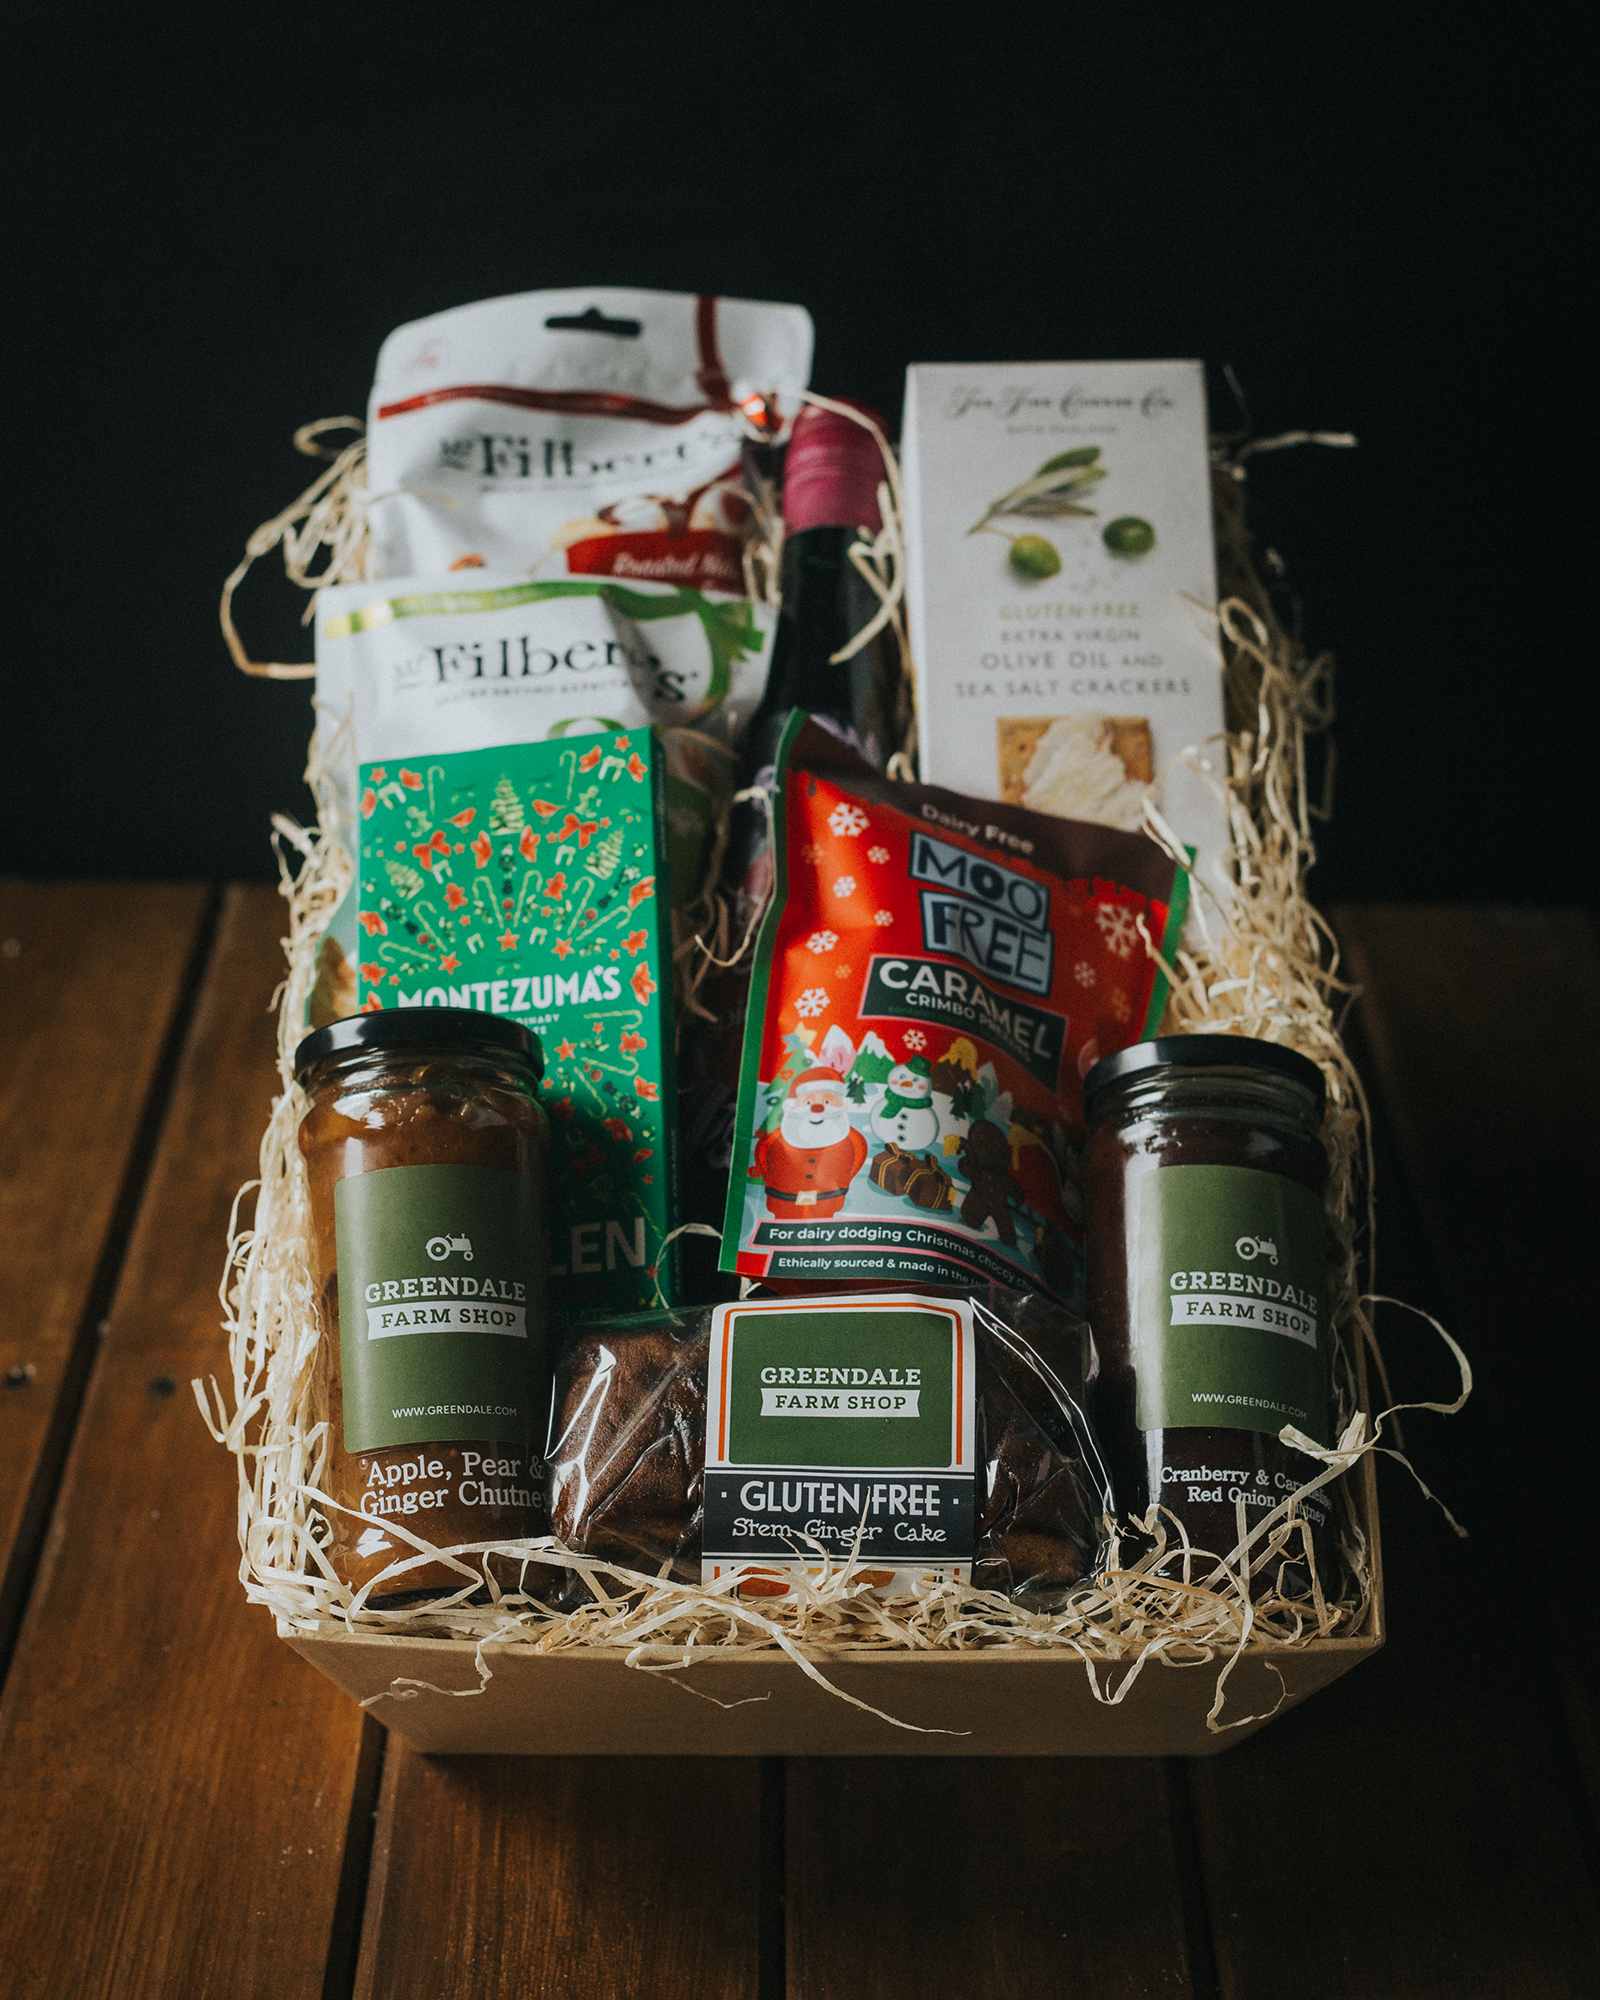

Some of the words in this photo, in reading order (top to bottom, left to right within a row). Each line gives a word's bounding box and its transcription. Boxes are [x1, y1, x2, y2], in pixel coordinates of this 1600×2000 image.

[980, 653, 1052, 670] OLIVE
[1068, 652, 1109, 669] OIL
[1121, 654, 1164, 668] AND
[955, 682, 995, 698] SEA
[1006, 681, 1058, 696] SALT
[1071, 679, 1191, 696] CRACKERS
[922, 803, 979, 837] Dairy
[985, 824, 1034, 855] Free
[917, 839, 1043, 922] MOO
[931, 900, 1047, 985] FREE
[879, 960, 1052, 1059] CARAMEL
[905, 992, 976, 1020] CRIMBO
[769, 1228, 795, 1240] For
[797, 1227, 835, 1242] dairy
[838, 1226, 902, 1242] dodging
[906, 1230, 976, 1259] Christmas
[978, 1254, 1016, 1283] choccy
[778, 1257, 832, 1271] Ethically
[834, 1256, 884, 1268] sourced
[886, 1258, 896, 1268] &
[899, 1259, 935, 1274] made
[937, 1264, 948, 1276] in
[951, 1269, 969, 1283] the
[364, 1276, 526, 1303] GREENDALE
[1170, 1271, 1318, 1316] GREENDALE
[381, 1308, 451, 1329] FARM
[459, 1308, 516, 1327] SHOP
[1186, 1301, 1255, 1320] FARM
[1263, 1308, 1311, 1335] SHOP
[760, 1367, 921, 1386] GREENDALE
[392, 1405, 517, 1418] WWW.GREENDALE.COM
[775, 1394, 840, 1410] FARM
[847, 1395, 907, 1410] SHOP
[1191, 1393, 1307, 1421] WWW.GREENDALE.COM
[367, 1454, 452, 1488] Apple,
[461, 1451, 521, 1477] Pear
[1161, 1465, 1250, 1486] Cranberry
[1255, 1469, 1270, 1486] &
[360, 1487, 449, 1516] Ginger
[740, 1481, 860, 1515] GLUTEN
[872, 1484, 941, 1517] FREE
[1187, 1486, 1223, 1503] Red
[1228, 1486, 1276, 1508] Onion
[731, 1518, 792, 1538] Stem
[804, 1519, 883, 1548] Ginger
[894, 1522, 948, 1543] Cake
